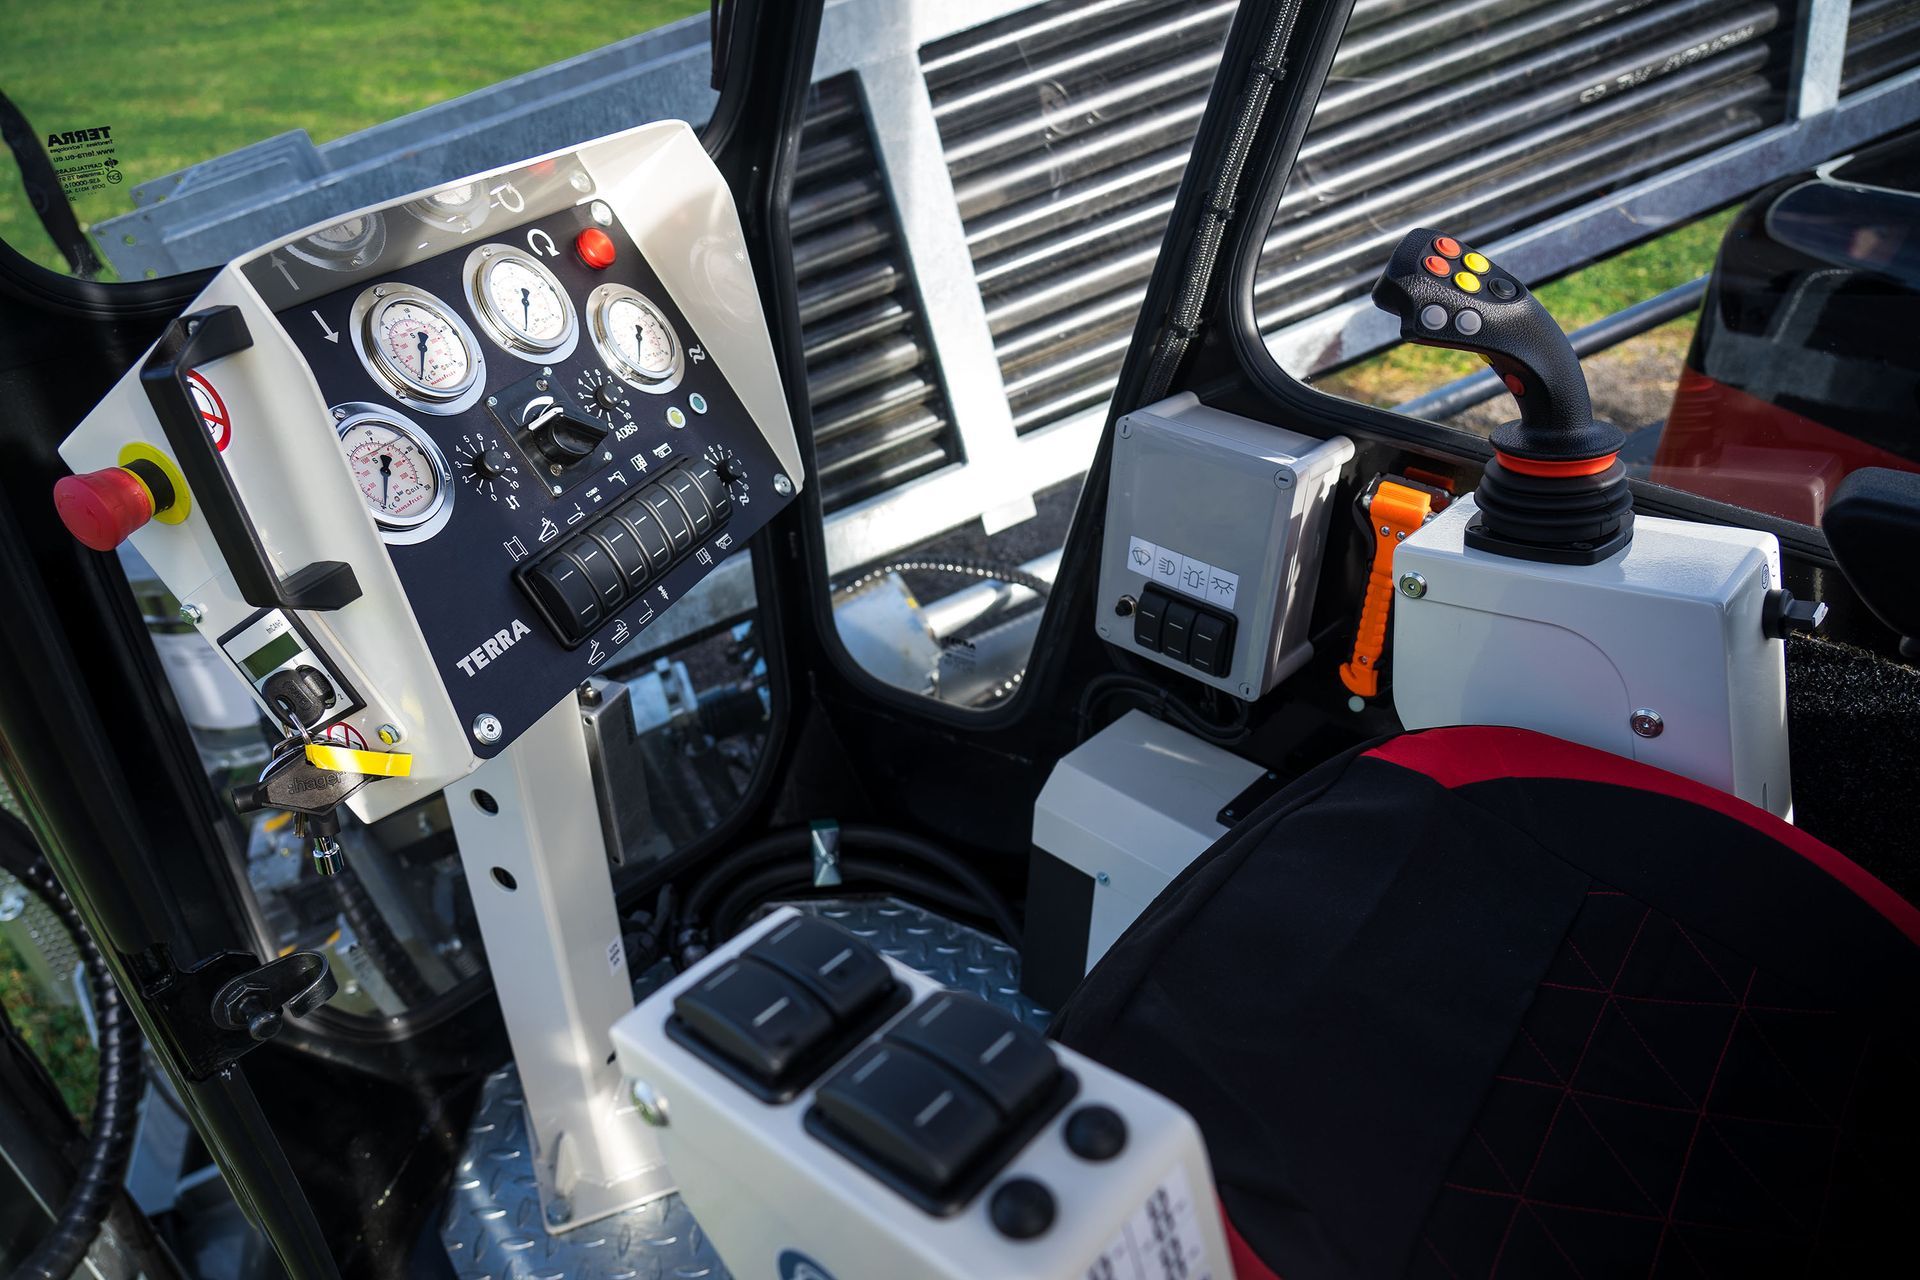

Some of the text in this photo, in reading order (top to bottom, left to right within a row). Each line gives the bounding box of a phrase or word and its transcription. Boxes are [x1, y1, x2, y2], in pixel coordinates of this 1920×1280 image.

[584, 405, 591, 413] 2
[615, 422, 638, 442] ADBS
[463, 435, 470, 443] 5
[511, 466, 518, 474] 9
[462, 476, 469, 484] 2
[510, 481, 519, 490] 10
[456, 619, 531, 677] TERRA
